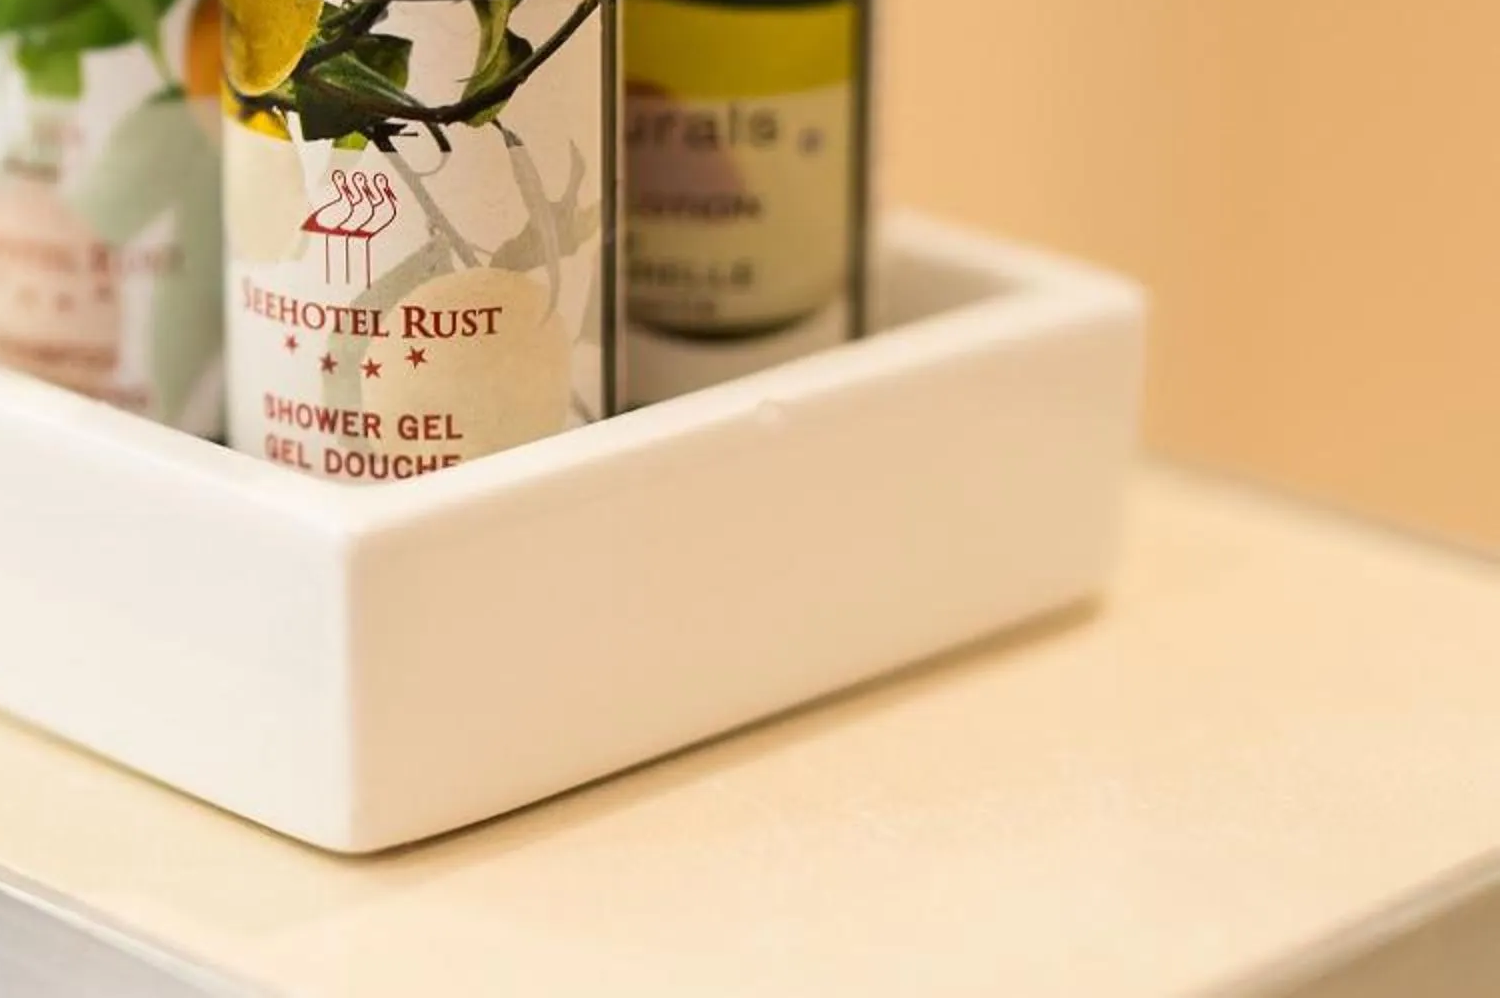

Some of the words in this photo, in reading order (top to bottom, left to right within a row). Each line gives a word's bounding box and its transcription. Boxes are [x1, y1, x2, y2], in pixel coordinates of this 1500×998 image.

[242, 277, 389, 337] SEEHOTEL
[401, 305, 503, 339] RUST
[264, 391, 382, 440] SHOWER
[398, 413, 464, 441] GEL
[264, 433, 312, 470] GEL
